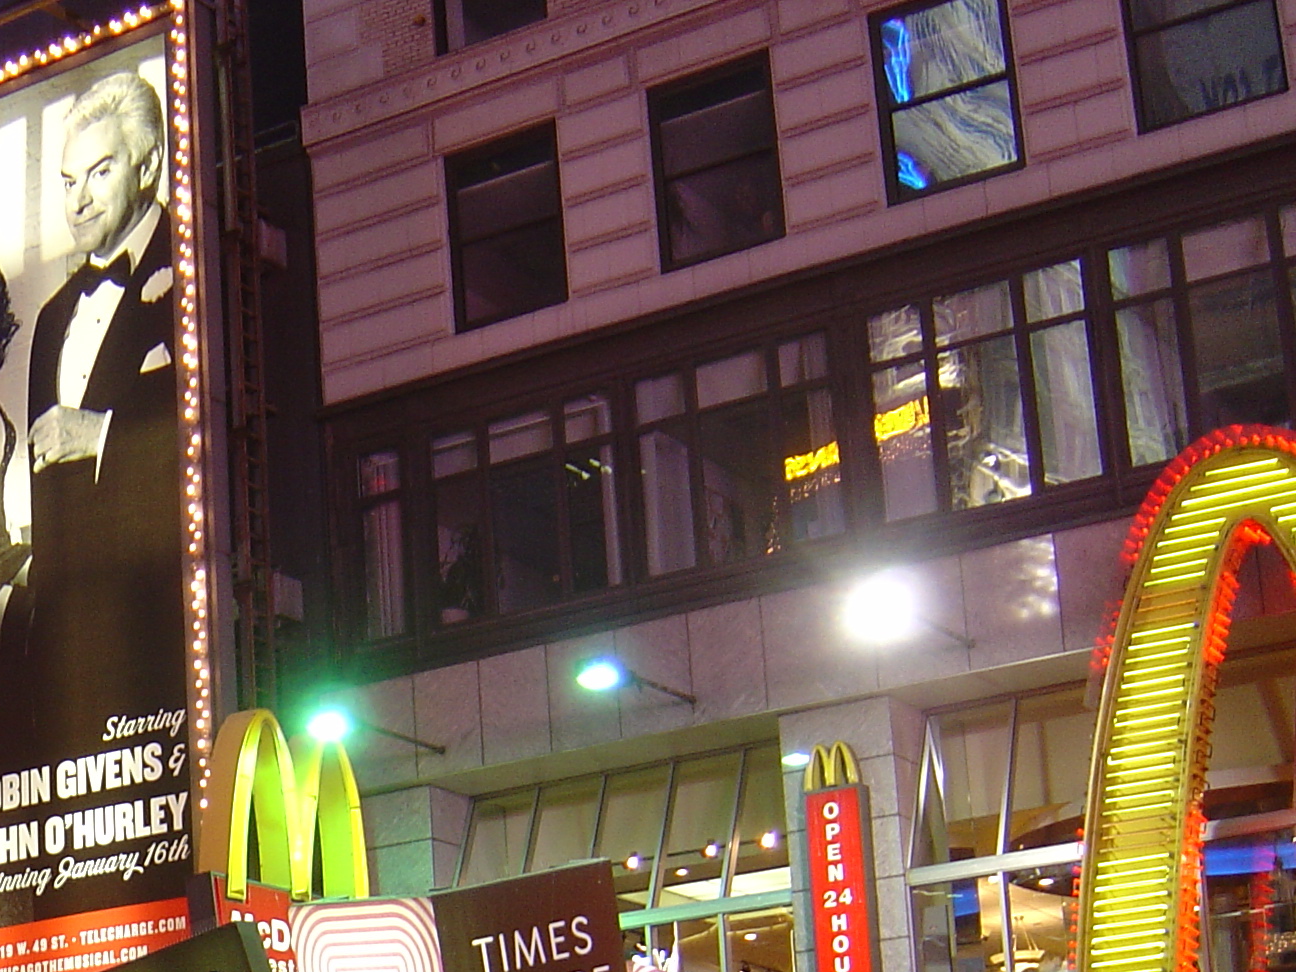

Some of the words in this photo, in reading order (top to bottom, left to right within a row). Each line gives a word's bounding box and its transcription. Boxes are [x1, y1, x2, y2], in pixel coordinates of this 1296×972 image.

[102, 708, 186, 741] Starring
[56, 742, 164, 801] GIVENS
[169, 743, 186, 777] &
[44, 791, 188, 855] O'HURLEY
[822, 801, 845, 882] OPEN
[54, 851, 145, 889] January
[144, 834, 191, 867] 16th
[822, 888, 854, 908] 24
[17, 940, 31, 955] W.
[32, 938, 48, 954] 49
[51, 935, 69, 950] ST.
[79, 914, 187, 946] TELECHARGE.COM
